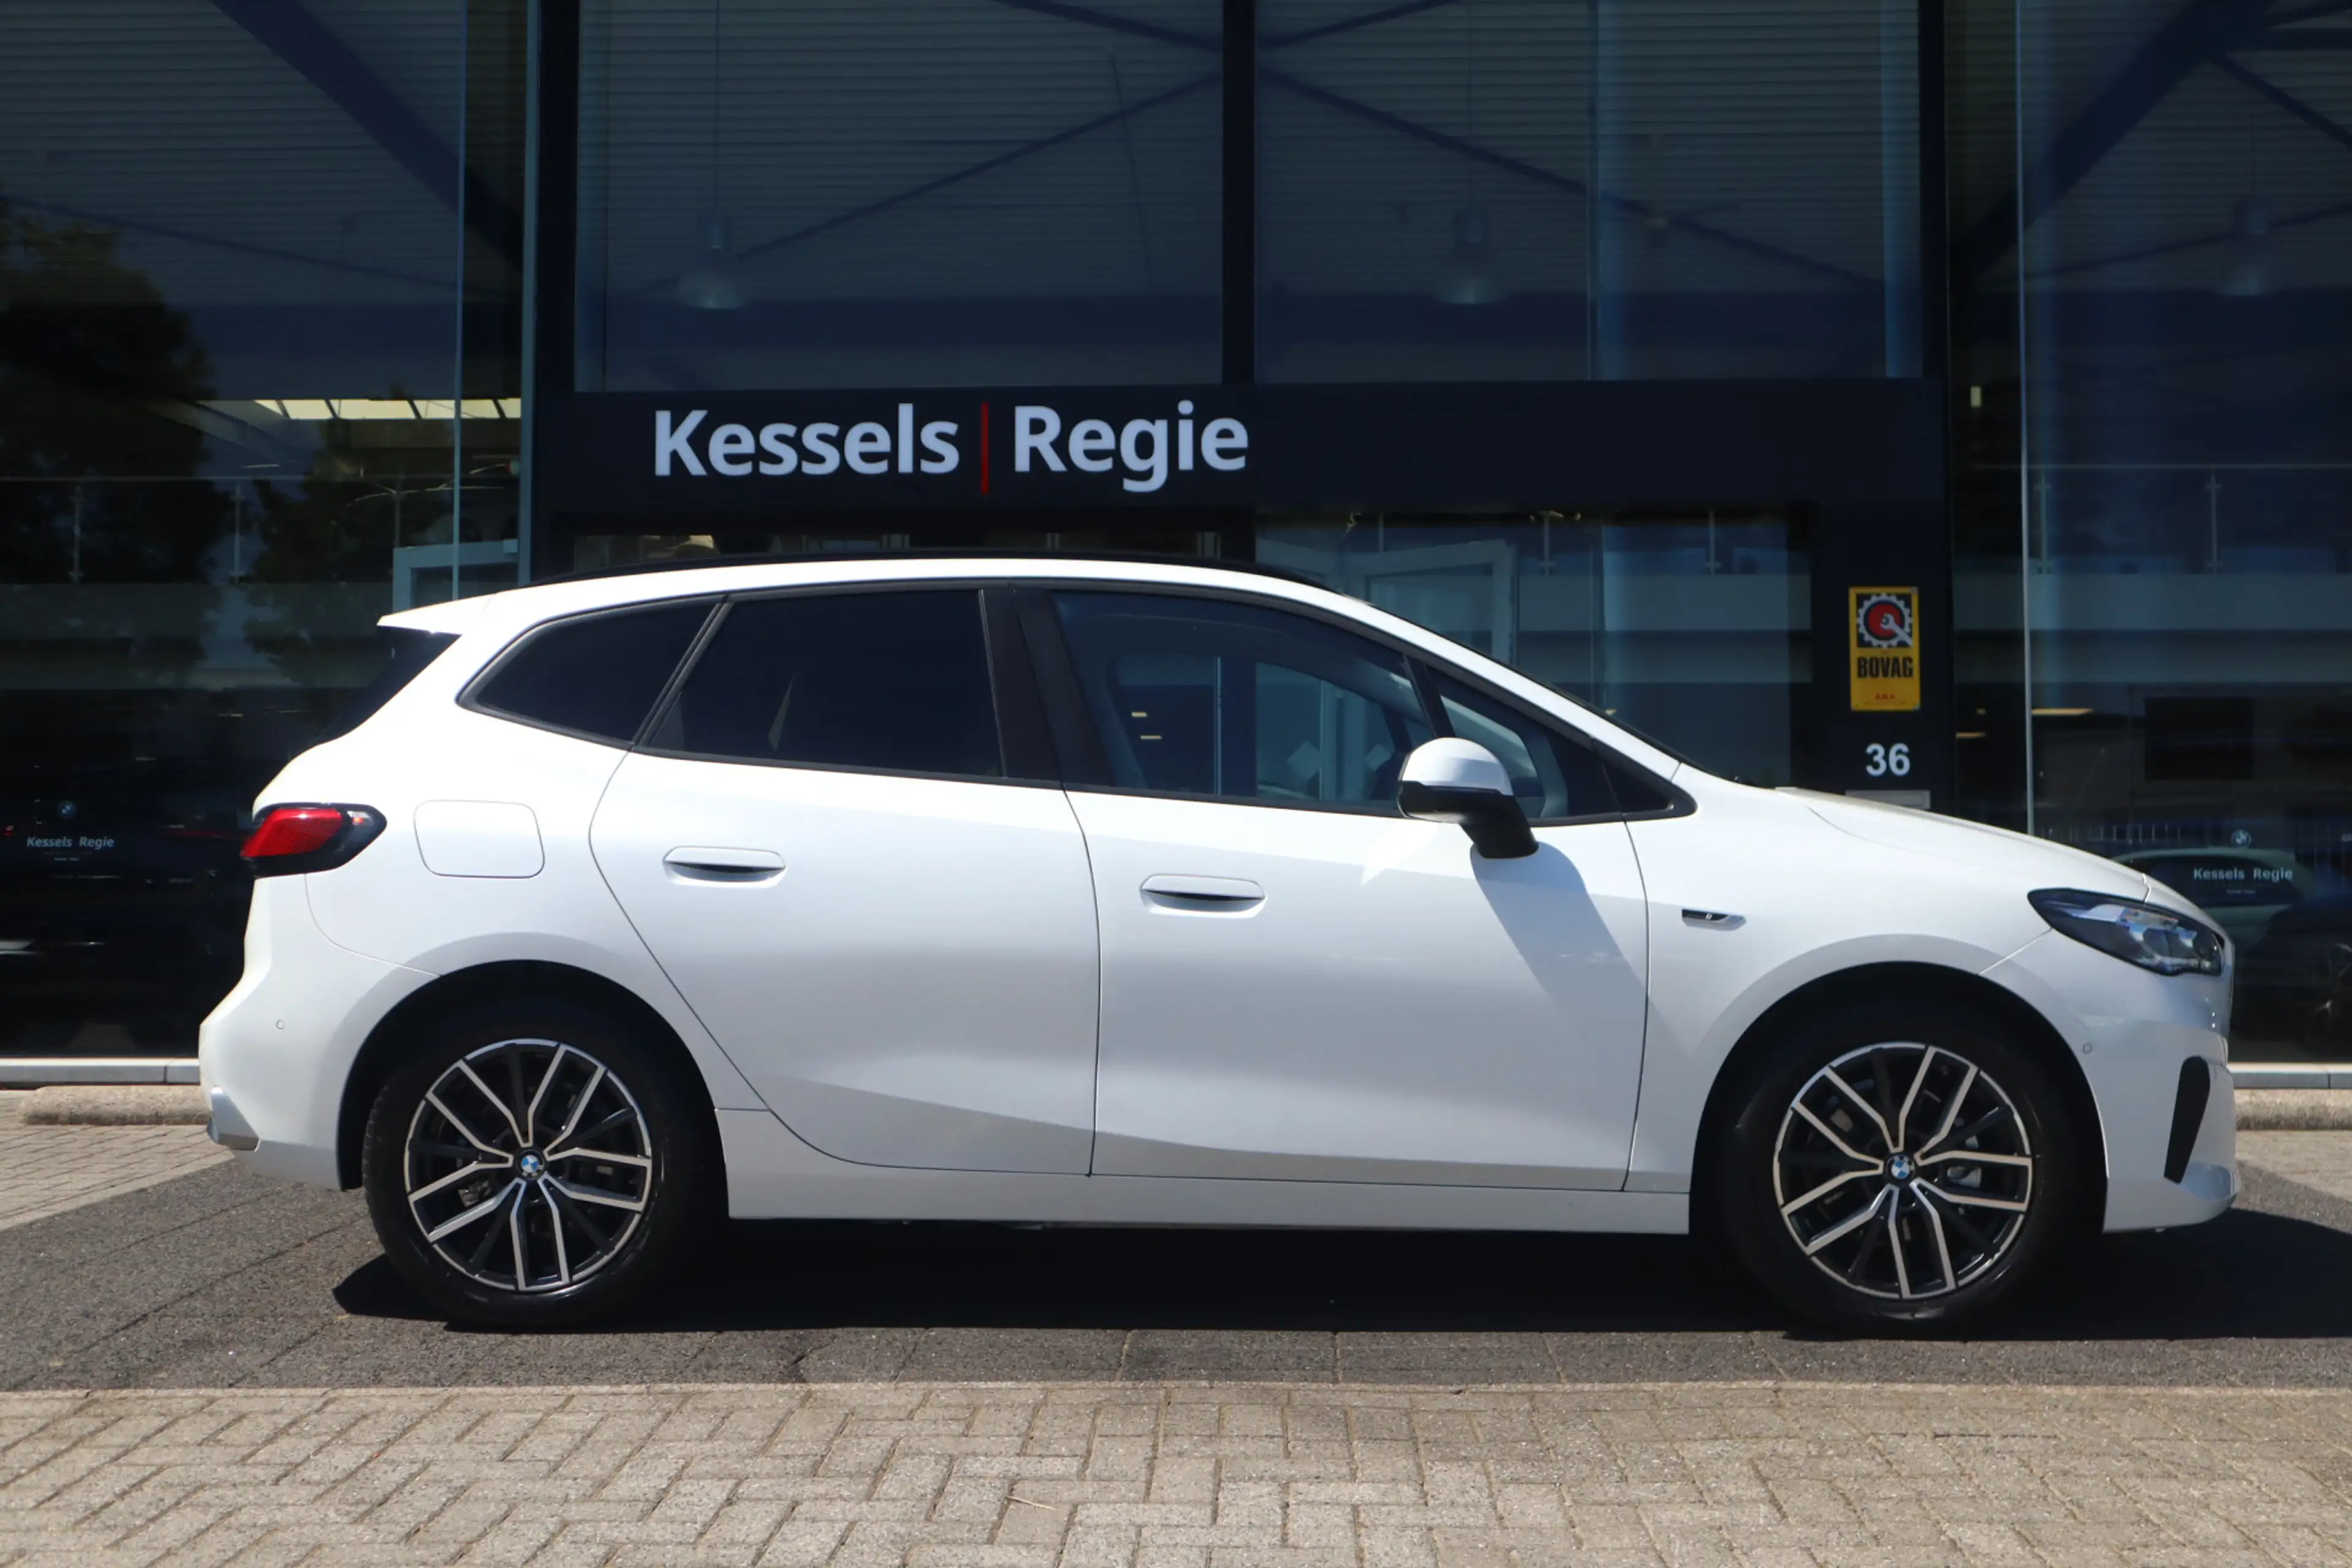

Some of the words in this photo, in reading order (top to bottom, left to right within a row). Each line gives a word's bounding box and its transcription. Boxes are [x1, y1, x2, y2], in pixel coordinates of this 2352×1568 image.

[654, 403, 959, 477] Kessels
[1014, 401, 1248, 492] Regie
[1857, 657, 1912, 678] BOVAG
[1866, 743, 1910, 776] 36
[26, 836, 73, 848] Kessels
[79, 836, 115, 850] Regie
